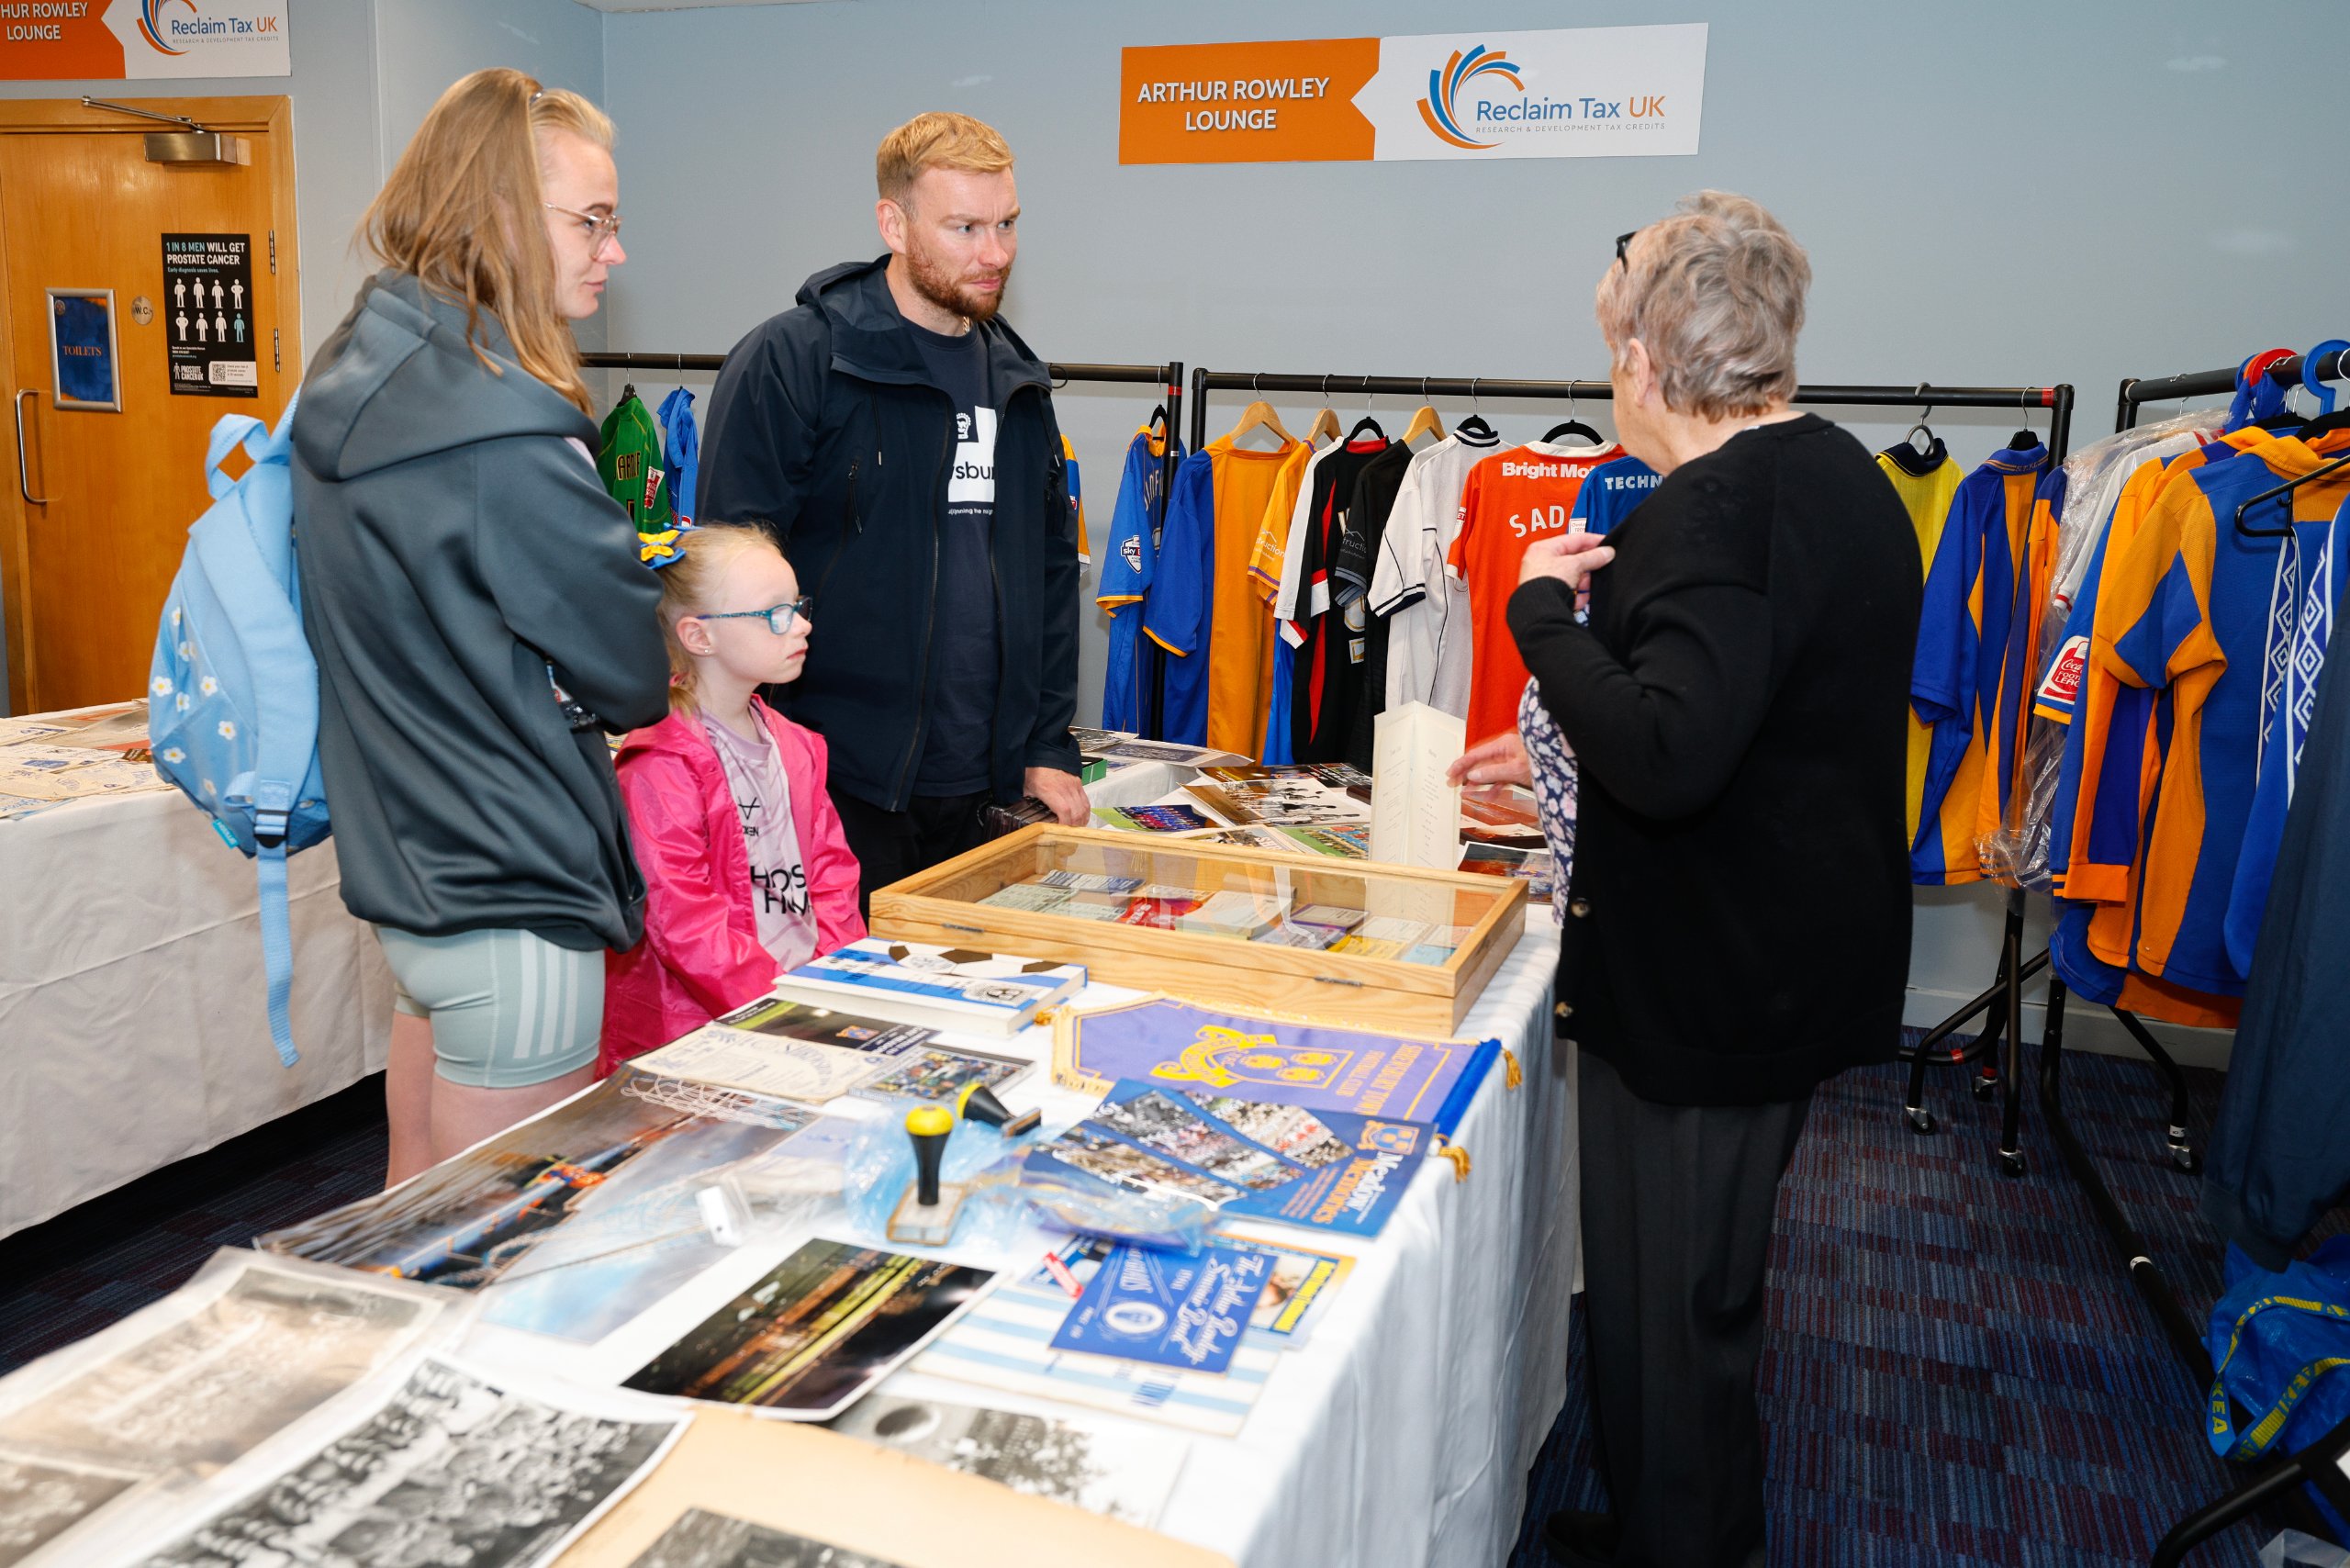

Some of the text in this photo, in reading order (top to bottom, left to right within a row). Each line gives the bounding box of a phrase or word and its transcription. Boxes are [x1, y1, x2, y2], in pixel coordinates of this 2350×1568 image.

[33, 2, 88, 17] ROWLEY
[6, 25, 62, 40] LOUNGE
[172, 17, 277, 35] Reclaim Tax UK
[1137, 77, 1329, 103] ARTHUR ROWLEY
[1477, 95, 1666, 121] Reclaim Tax UK
[1185, 109, 1277, 131] LOUNGE
[1536, 124, 1601, 132] DEVELOPMENT
[166, 242, 245, 252] 1 IN 8 MEN WILL GET
[167, 253, 241, 265] PROSTATE CANCER
[62, 345, 102, 356] TOILETS
[1502, 462, 1558, 479] Bright
[1508, 505, 1565, 538] SAD
[1123, 546, 1136, 556] sky
